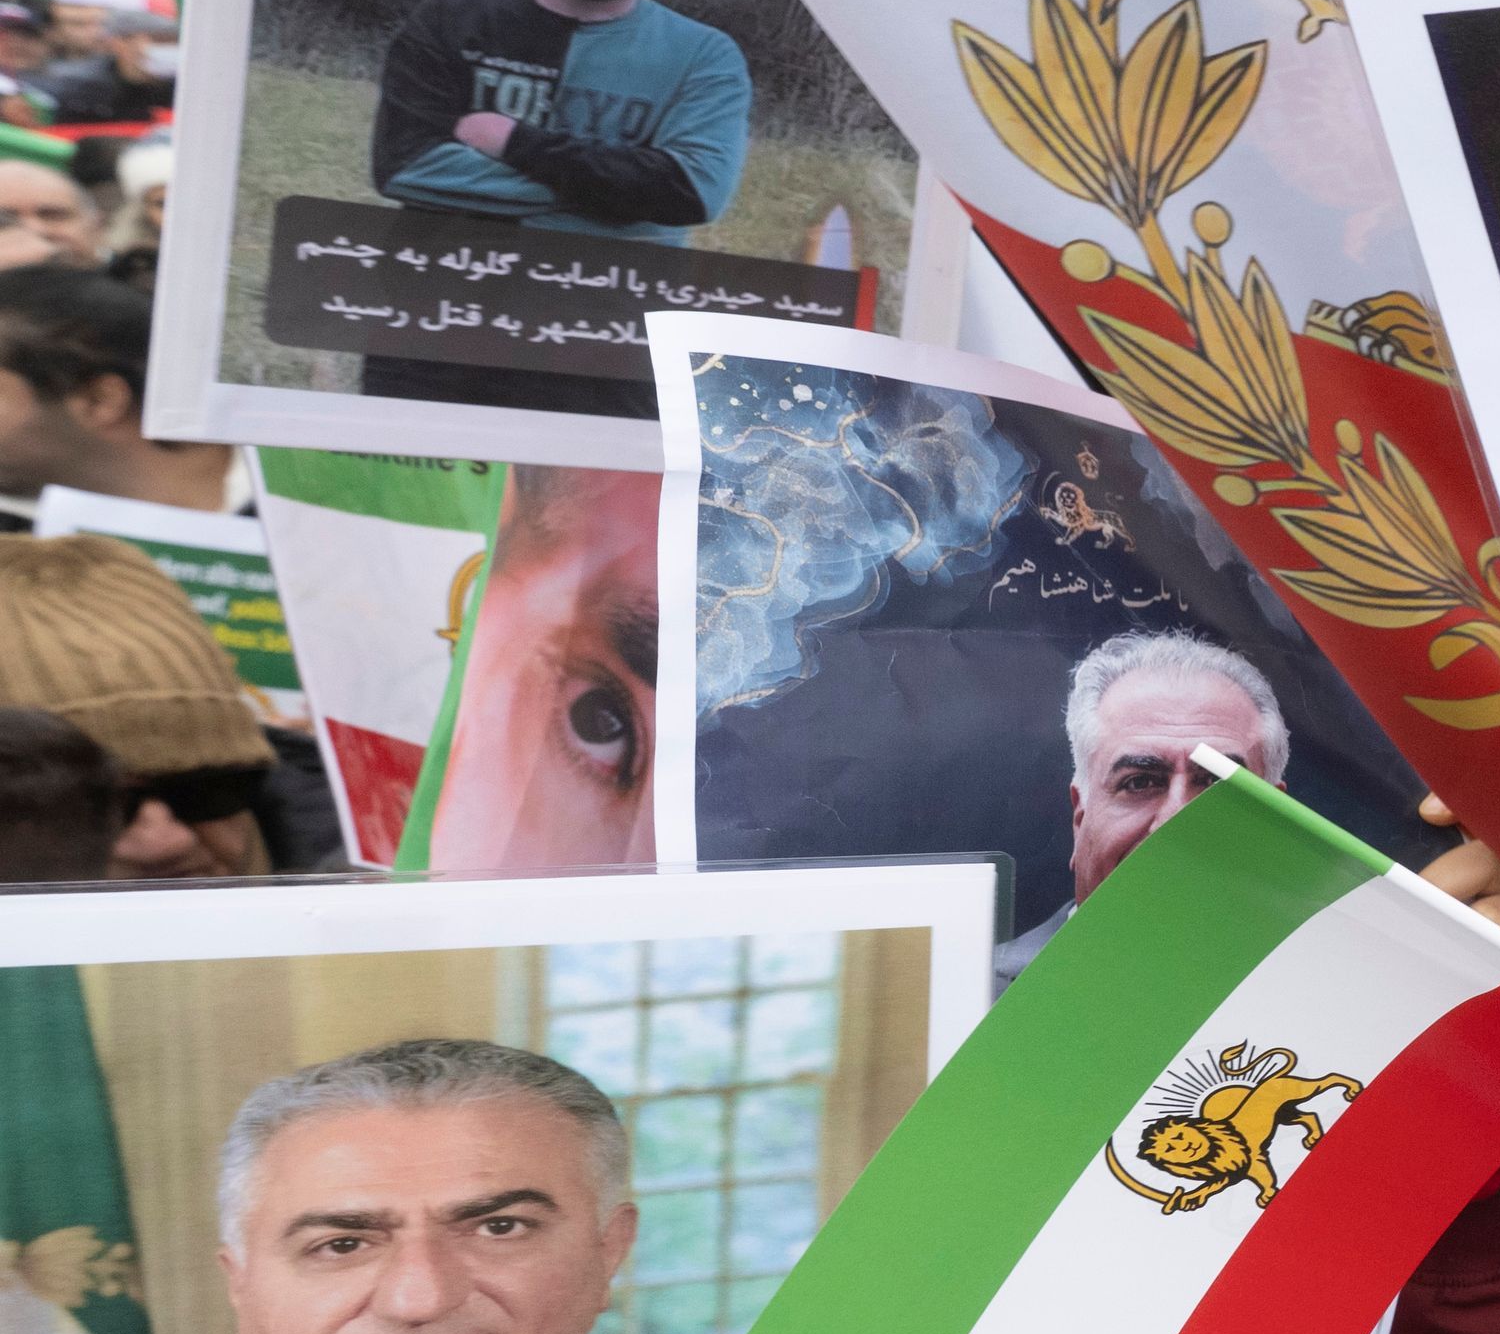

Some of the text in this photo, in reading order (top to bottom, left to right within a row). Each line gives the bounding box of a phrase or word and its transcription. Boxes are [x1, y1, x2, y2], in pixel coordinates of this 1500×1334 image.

[298, 234, 385, 262] چشم
[397, 246, 429, 270] به
[438, 245, 520, 277] گلوله
[528, 264, 619, 291] اصابت
[626, 267, 646, 294] با
[321, 294, 407, 328] رسید
[420, 298, 482, 332] قتل
[774, 288, 843, 318] سعید
[492, 310, 523, 334] به
[1121, 577, 1171, 608] ملت
[1178, 587, 1189, 612] ما
